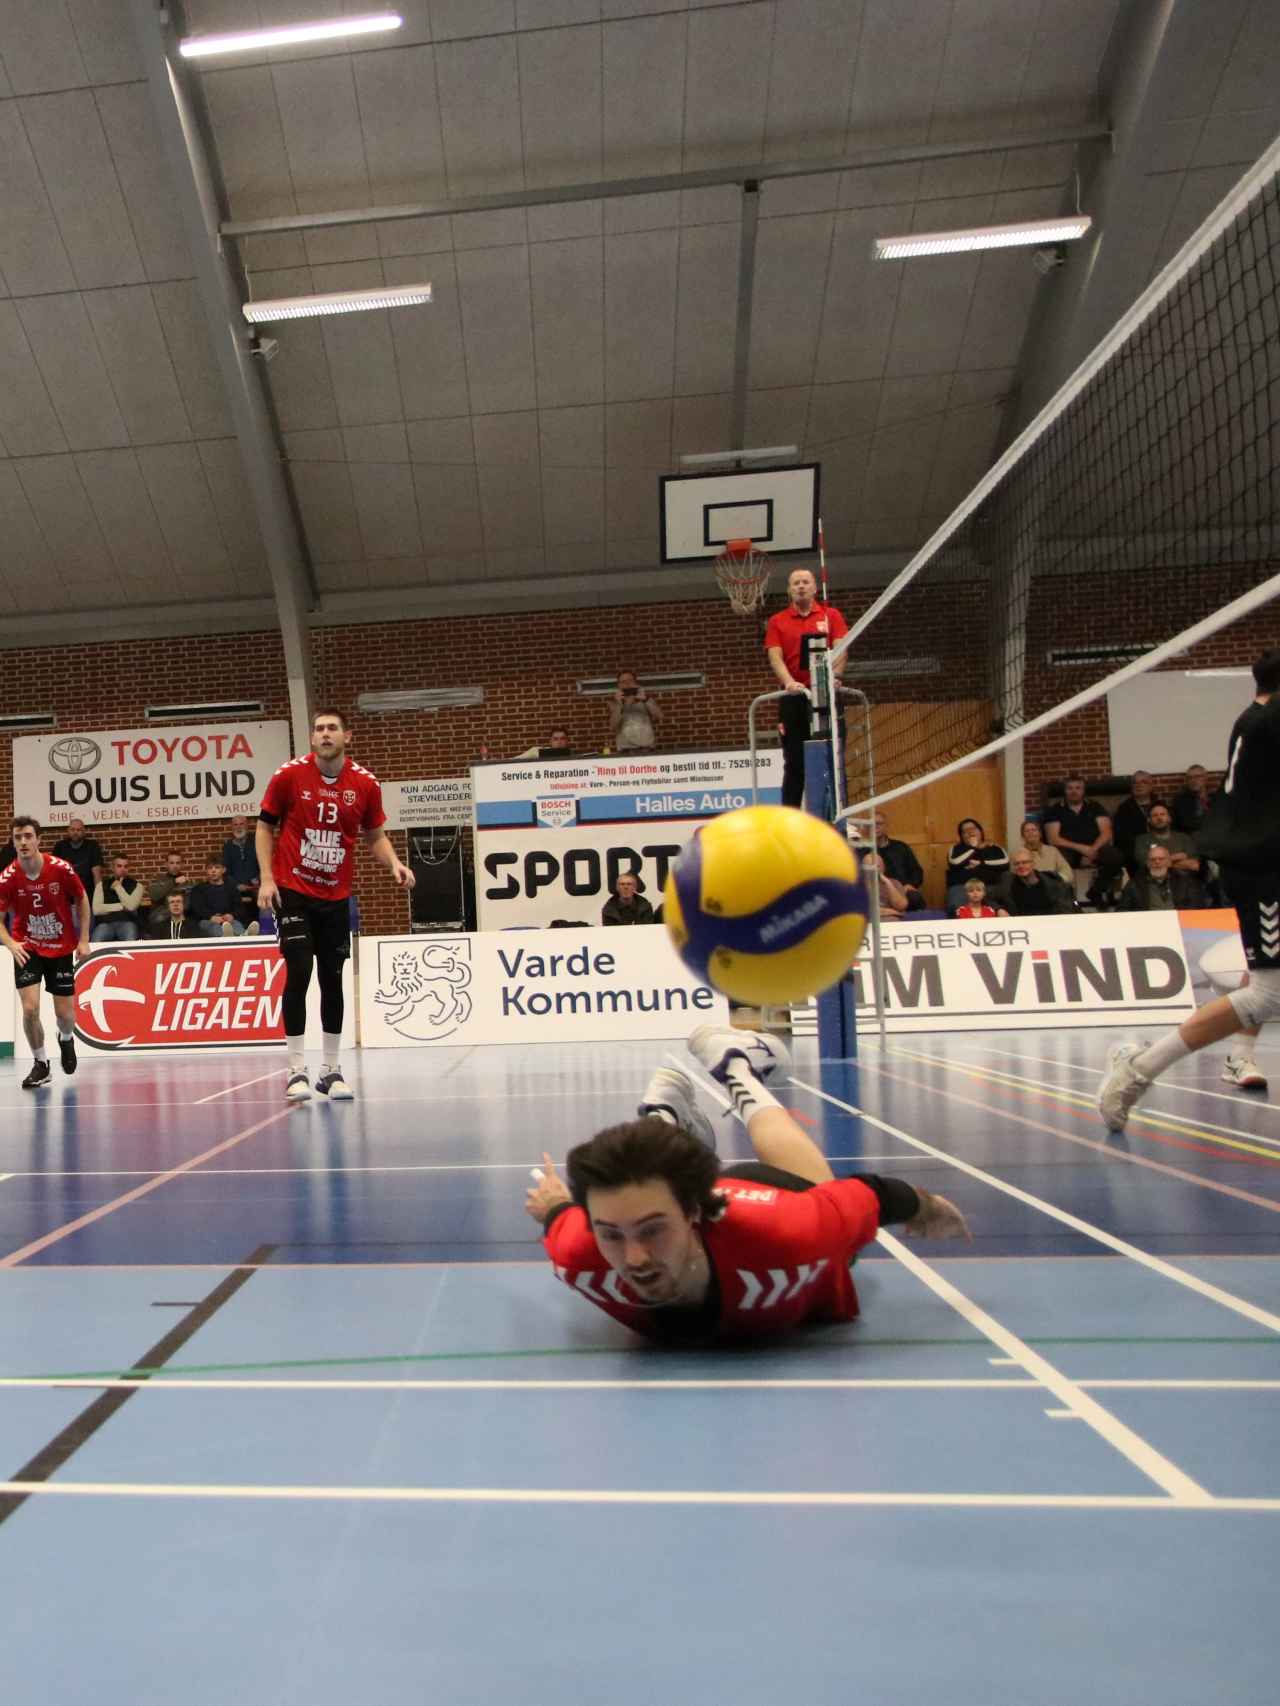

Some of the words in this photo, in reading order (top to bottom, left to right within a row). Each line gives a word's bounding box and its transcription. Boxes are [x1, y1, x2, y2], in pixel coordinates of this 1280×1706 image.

[111, 734, 254, 766] TOYOTA
[501, 770, 533, 781] Service
[535, 770, 542, 779] &
[543, 769, 589, 779] Reparation
[597, 766, 616, 776] Ring
[630, 764, 657, 774] Dorthe
[660, 764, 670, 774] og
[673, 761, 696, 772] bestil
[728, 758, 771, 768] 7529283
[49, 775, 150, 806] LOUIS
[160, 770, 255, 800] LUND
[400, 785, 419, 793] KUN
[422, 783, 458, 792] ADGANG
[92, 809, 129, 821] VEJEN
[147, 806, 199, 818] ESBJERG
[216, 802, 256, 814] VARDE
[317, 802, 338, 823] 13
[541, 800, 571, 809] BOSCH
[542, 808, 571, 816] Service
[635, 795, 696, 813] Halles
[700, 793, 746, 810] Auto
[300, 839, 345, 864] WATER
[32, 893, 43, 908] 2
[497, 946, 616, 978] Varde
[154, 958, 286, 995] VOLLEY
[502, 985, 714, 1016] Kommune
[151, 996, 282, 1032] LIGAEN
